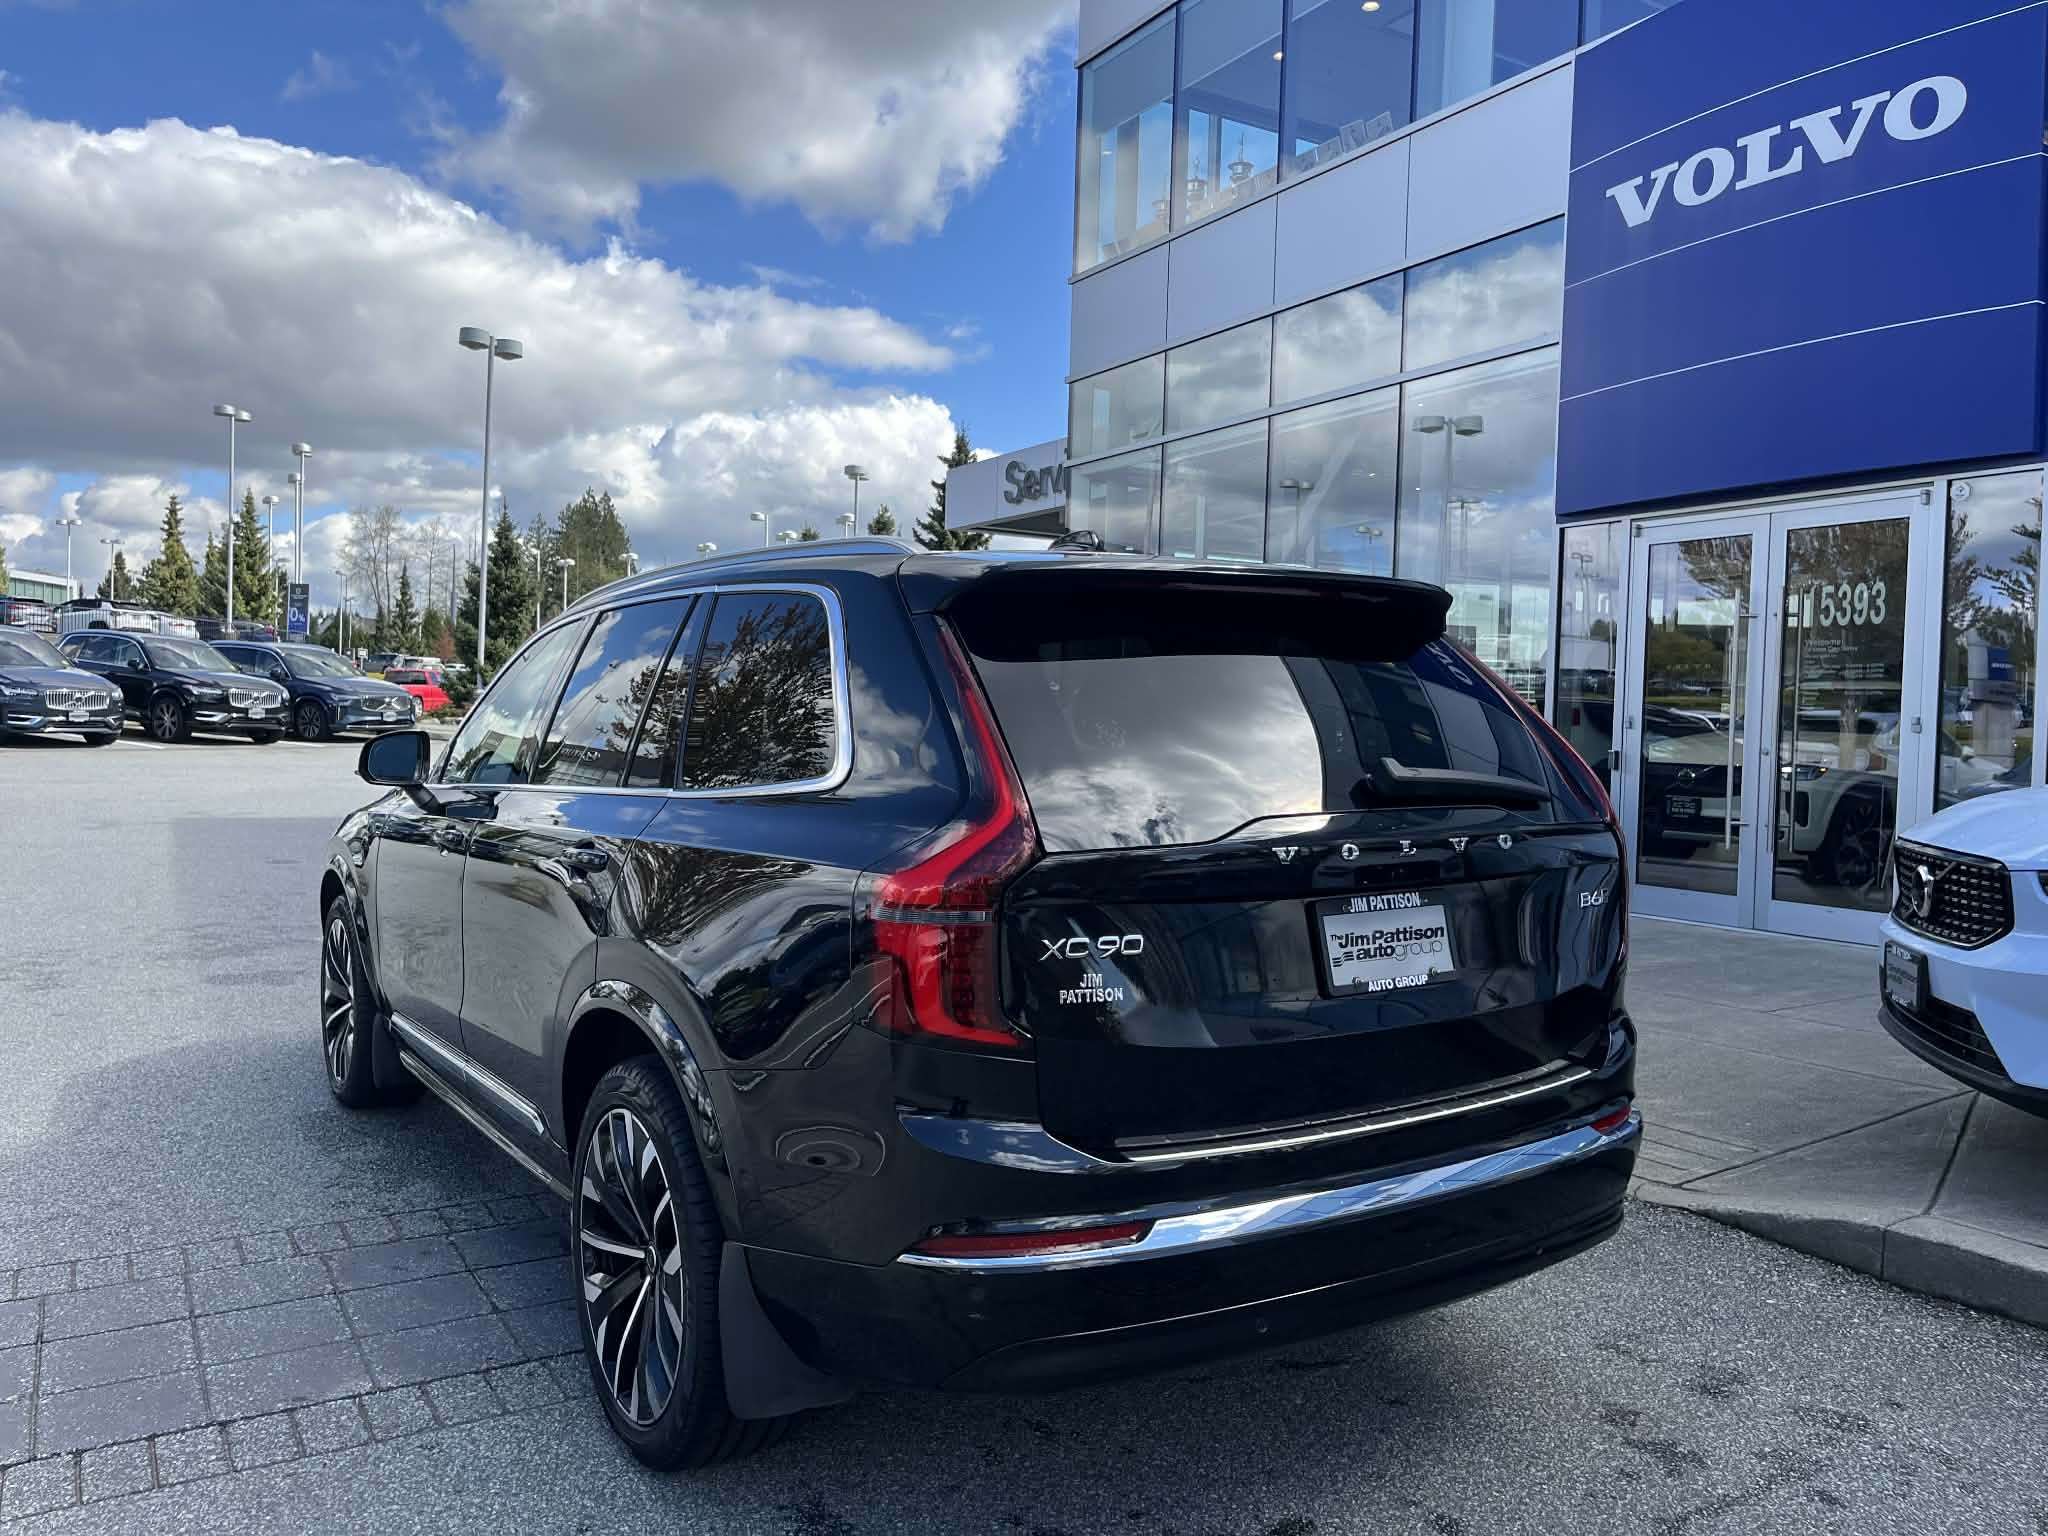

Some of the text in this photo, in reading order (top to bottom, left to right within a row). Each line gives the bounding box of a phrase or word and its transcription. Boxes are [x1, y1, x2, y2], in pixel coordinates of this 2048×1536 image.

[1606, 75, 1968, 228] VOLVO
[1003, 449, 1067, 504] Serv
[1808, 581, 1886, 627] 15393
[1272, 833, 1513, 865] VOLVO
[1349, 892, 1421, 913] JIM PATTISON
[1080, 973, 1103, 988] JIM
[1368, 974, 1429, 992] AUTO GROUP
[1059, 987, 1124, 1004] PATTISON
